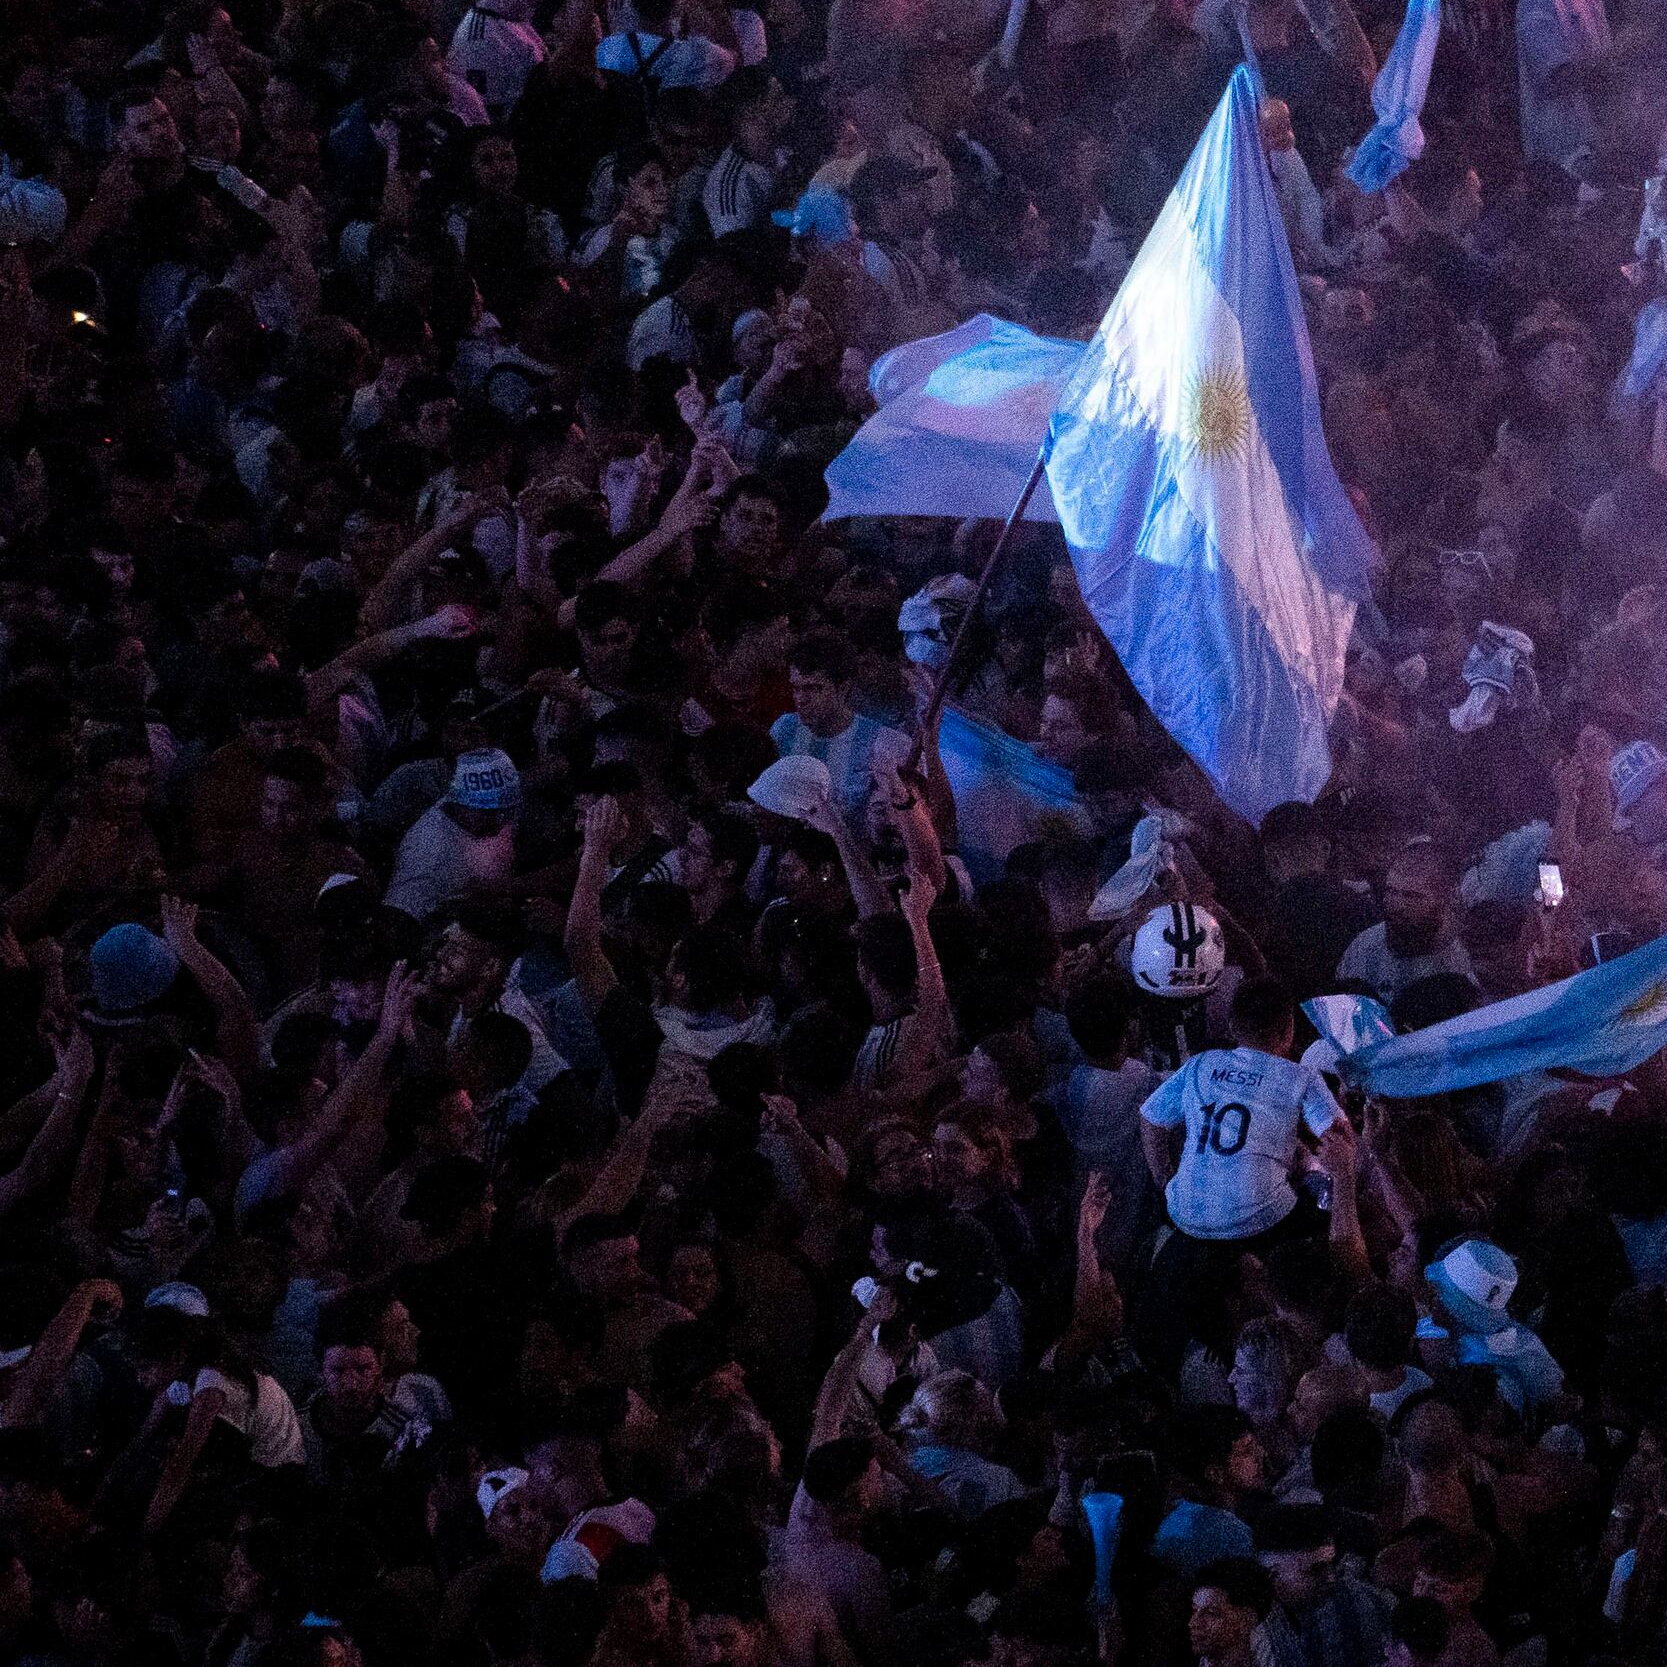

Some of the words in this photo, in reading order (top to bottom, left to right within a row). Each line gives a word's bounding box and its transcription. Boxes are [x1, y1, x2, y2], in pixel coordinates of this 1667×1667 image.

[463, 768, 504, 792] 1960
[1210, 1068, 1265, 1088] MESSI
[1196, 1102, 1251, 1156] 10
